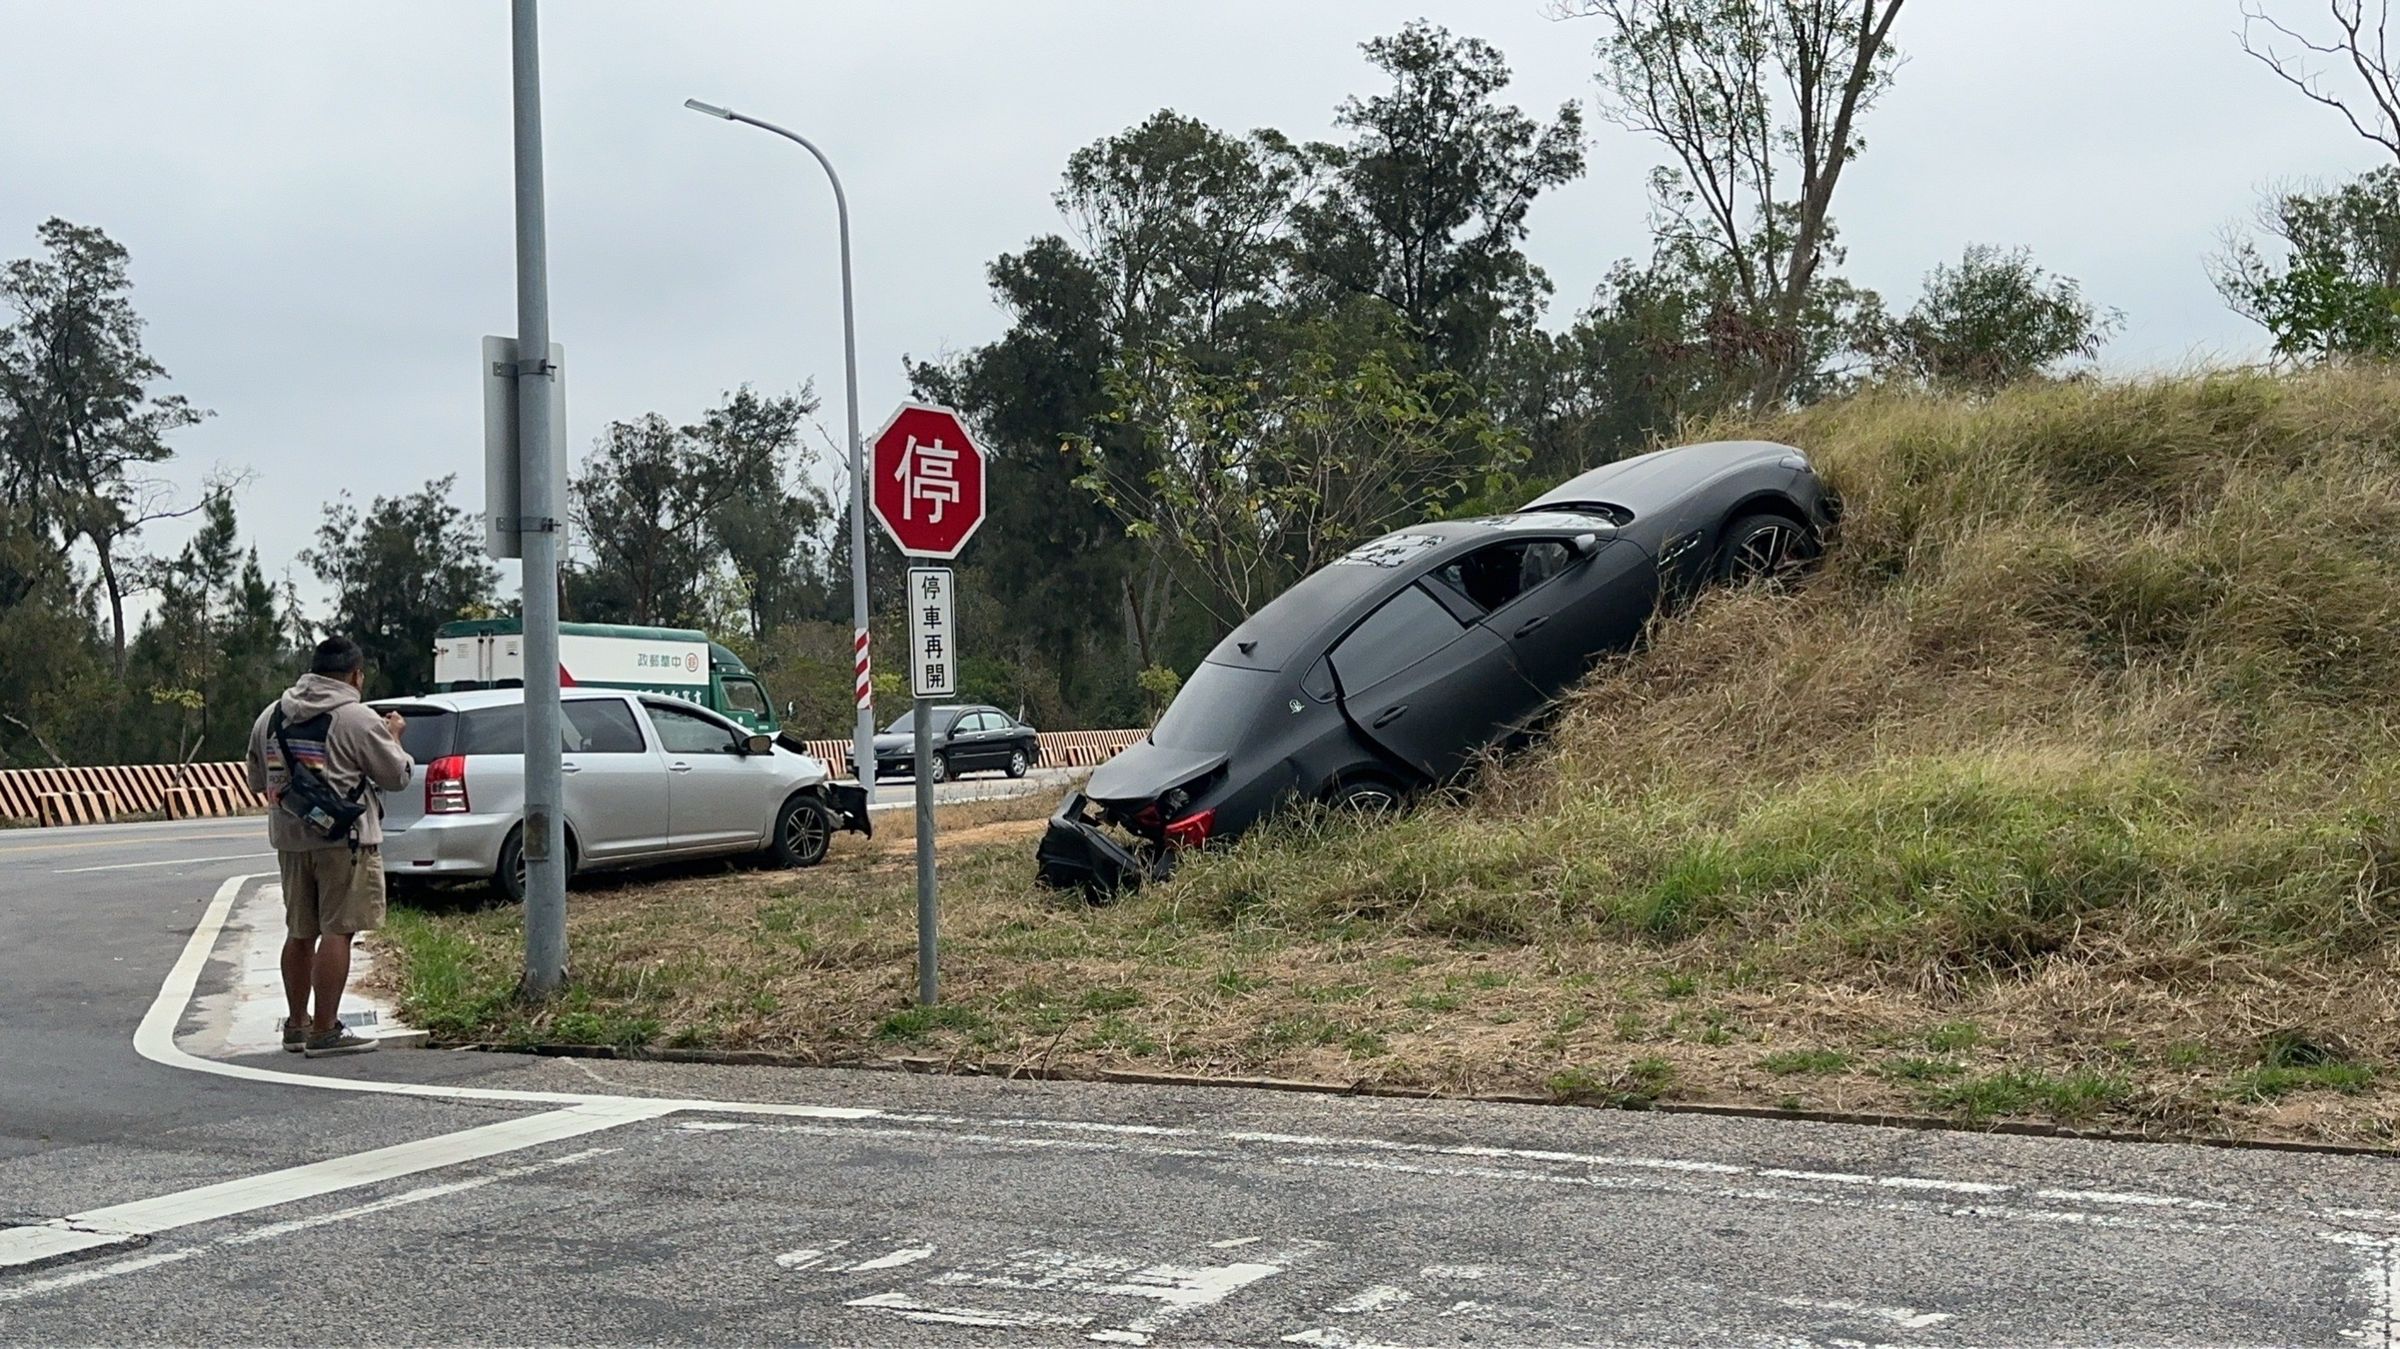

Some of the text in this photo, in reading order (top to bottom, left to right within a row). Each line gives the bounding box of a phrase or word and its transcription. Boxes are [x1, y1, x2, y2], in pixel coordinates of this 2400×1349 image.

[894, 434, 960, 524] 停
[921, 575, 946, 689] 停車再開
